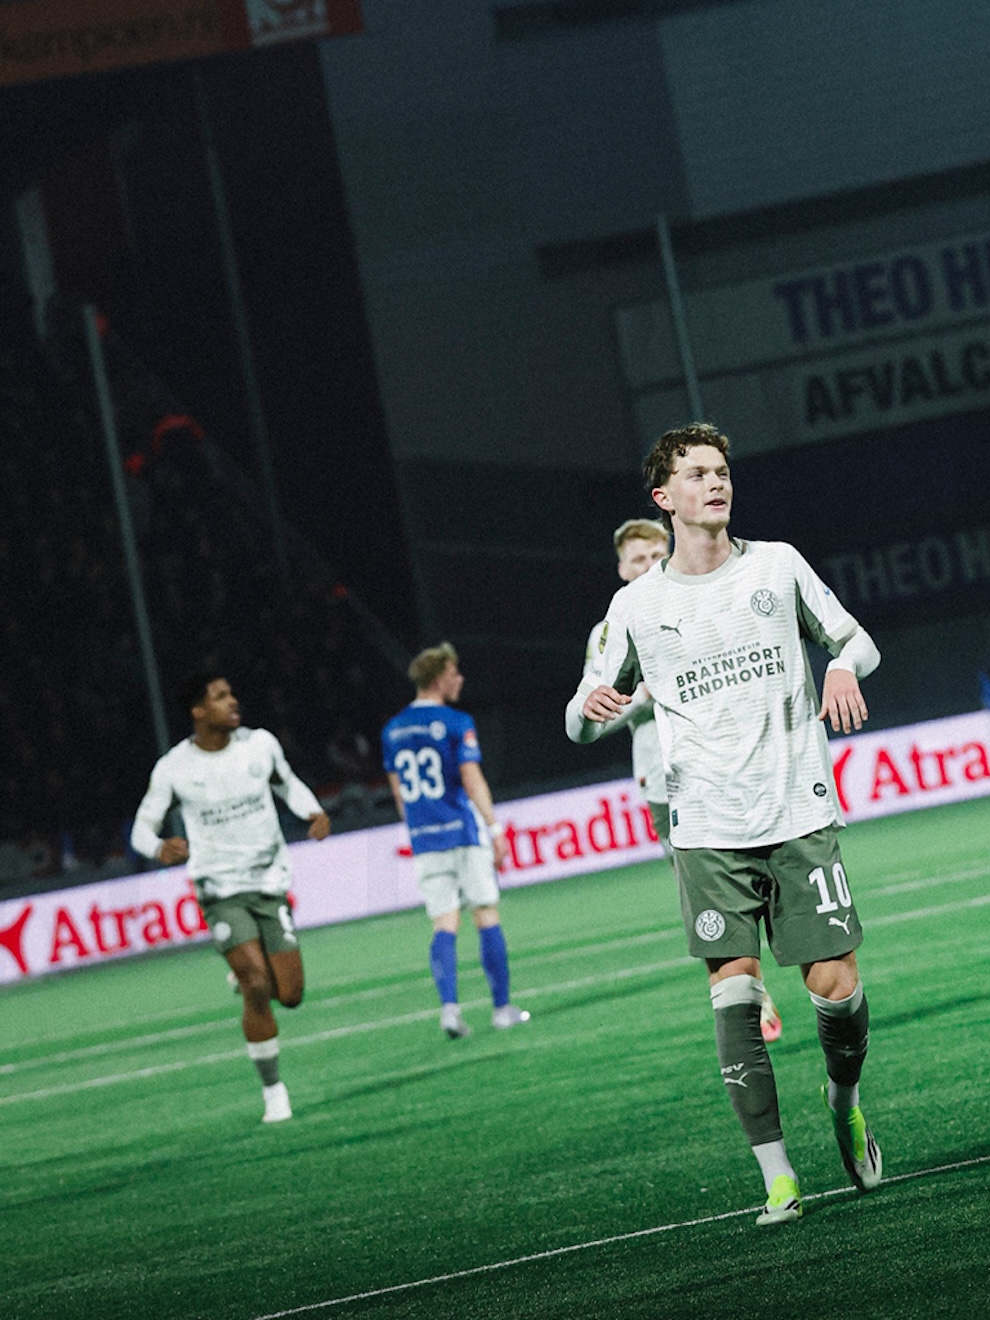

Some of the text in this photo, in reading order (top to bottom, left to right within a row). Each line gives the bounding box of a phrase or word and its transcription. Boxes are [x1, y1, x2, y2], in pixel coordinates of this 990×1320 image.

[773, 256, 932, 343] THEO
[822, 536, 952, 602] THEO
[676, 646, 782, 688] BRAINPORT
[679, 660, 785, 703] EINDHOVEN
[394, 746, 445, 803] 33
[808, 862, 852, 914] 10
[50, 879, 209, 962] Atrad
